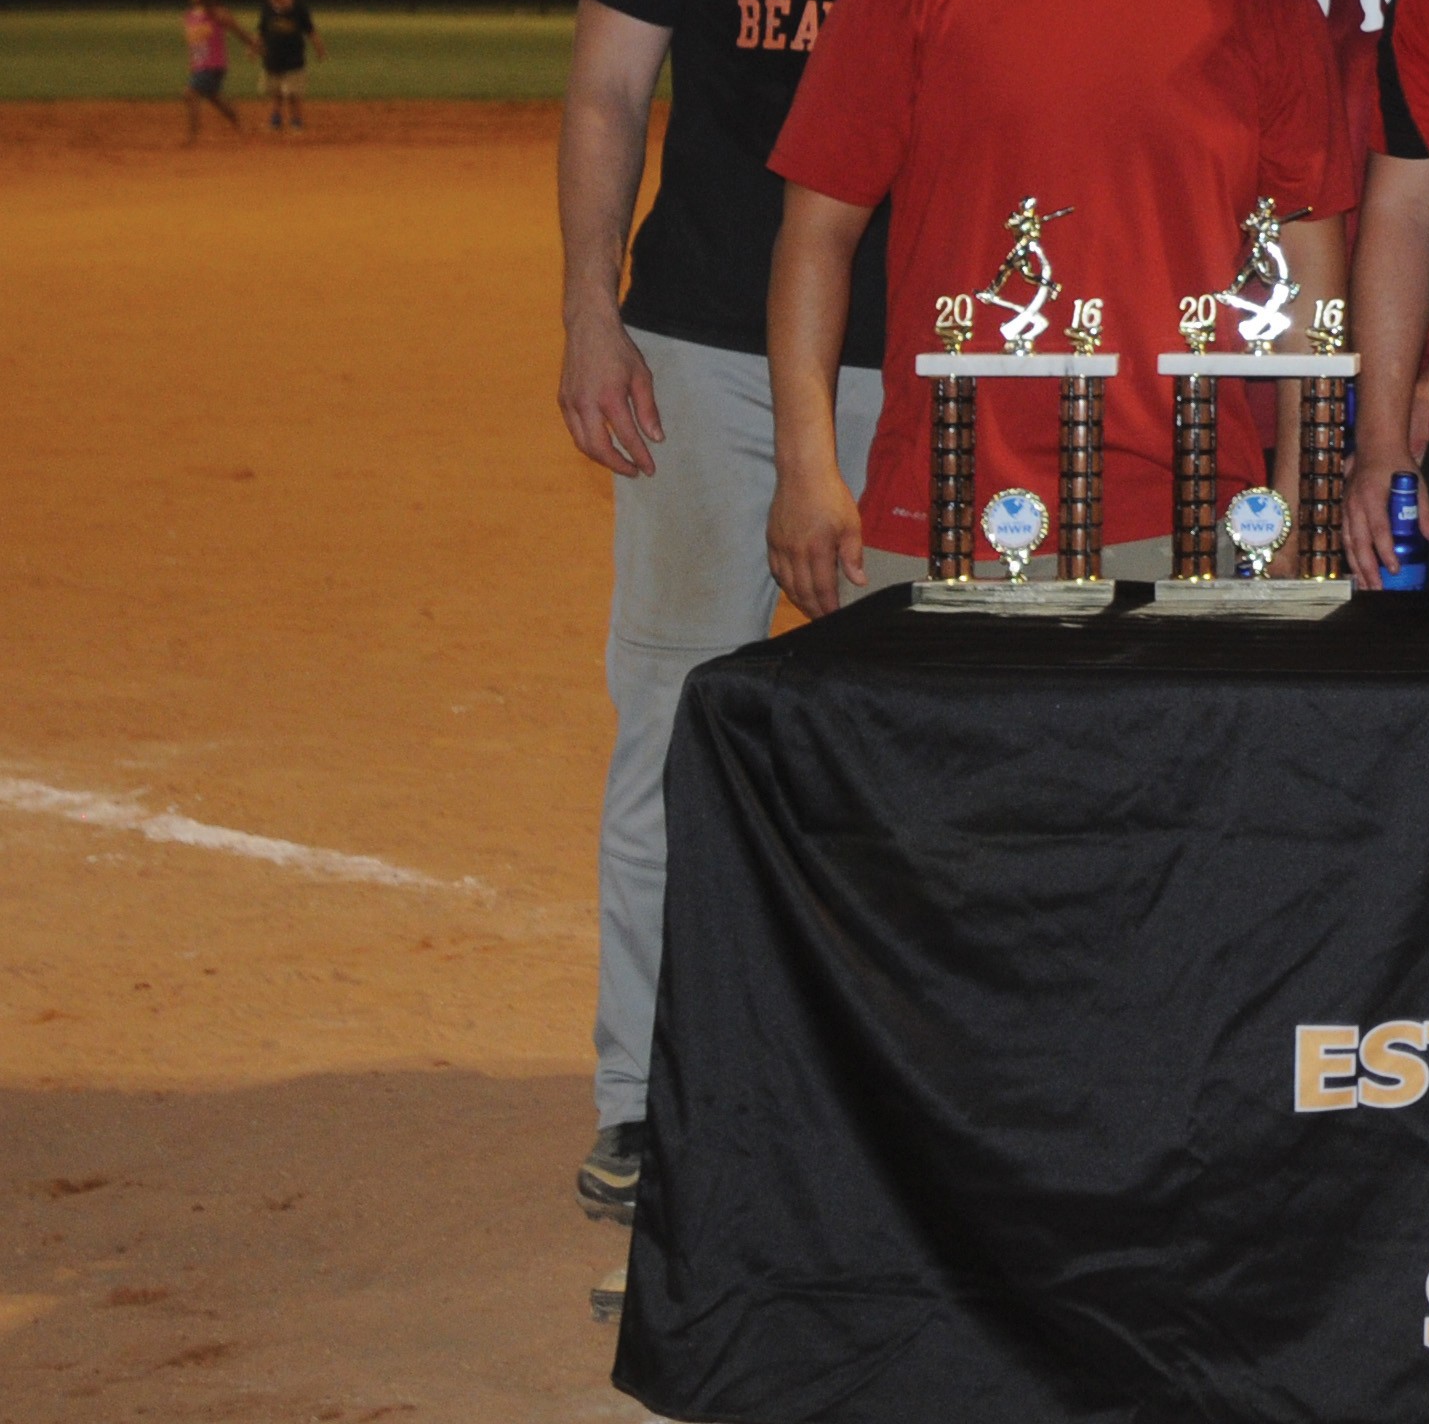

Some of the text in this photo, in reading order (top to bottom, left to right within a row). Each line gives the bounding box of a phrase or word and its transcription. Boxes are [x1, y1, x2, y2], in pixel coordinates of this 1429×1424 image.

[936, 295, 1103, 327] 20 16
[1180, 295, 1344, 327] 20 16
[997, 521, 1034, 536] MWR
[1240, 519, 1277, 534] MWR
